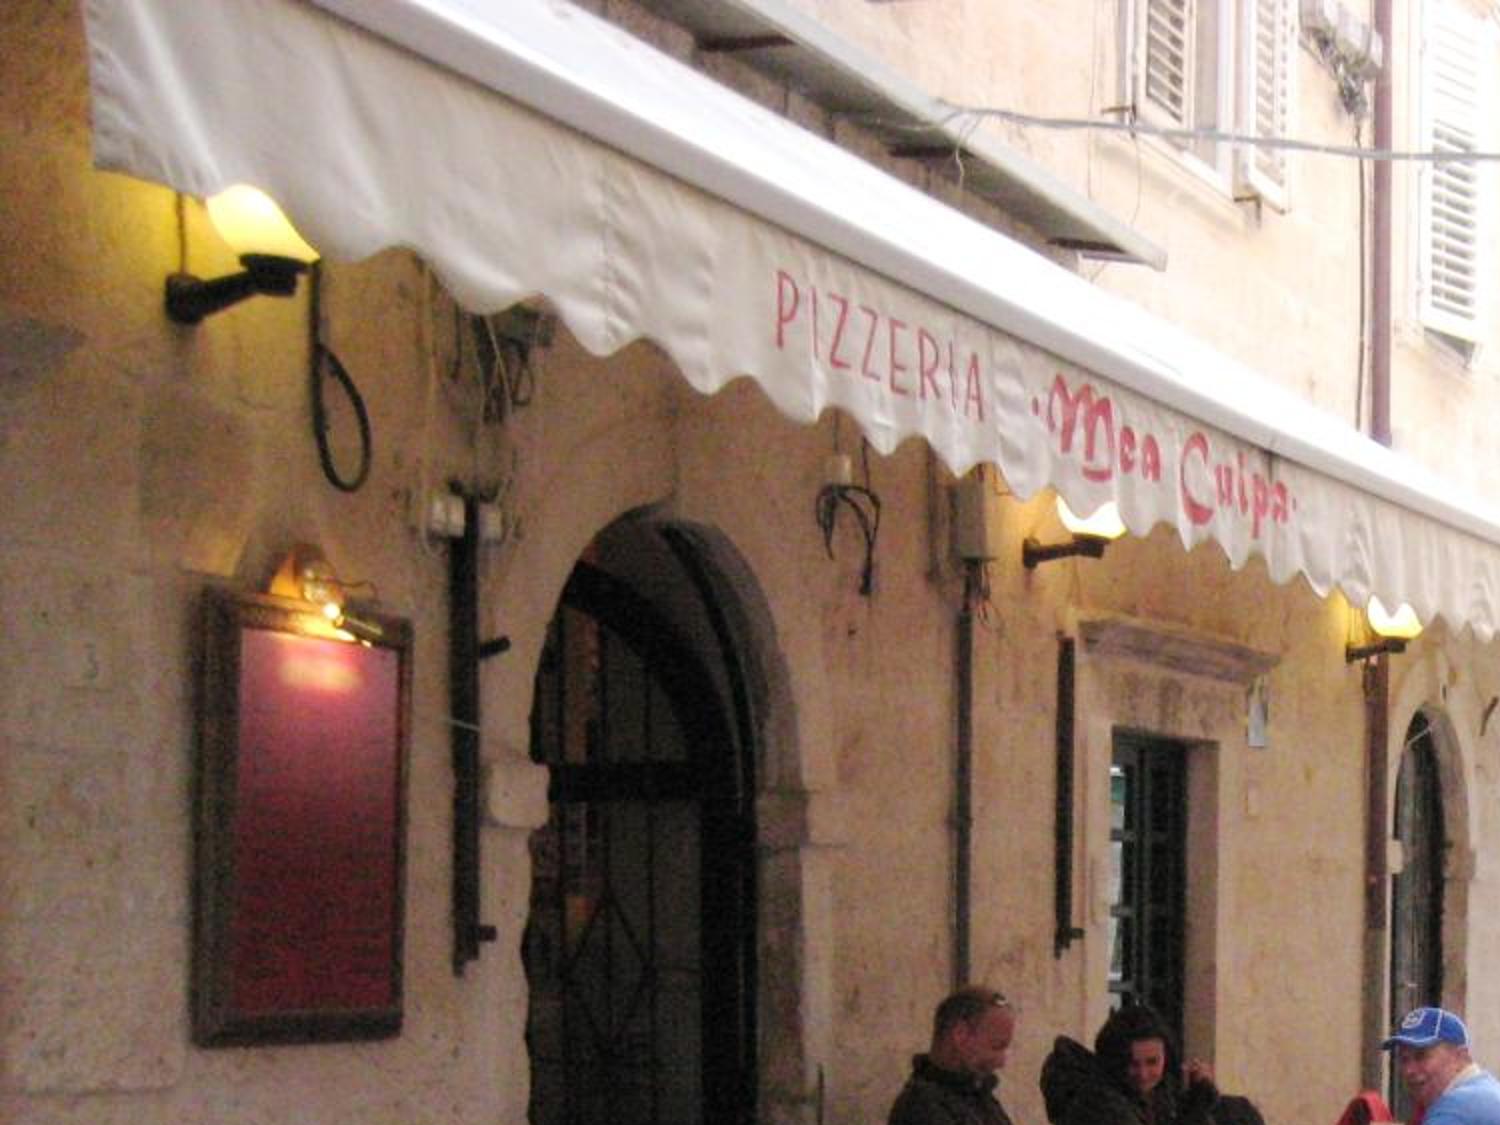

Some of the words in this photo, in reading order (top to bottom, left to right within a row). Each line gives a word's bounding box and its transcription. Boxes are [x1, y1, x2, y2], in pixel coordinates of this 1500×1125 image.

[774, 269, 985, 423] PIZZERIA
[1047, 373, 1162, 481] Mea
[1178, 431, 1290, 538] Culpa
